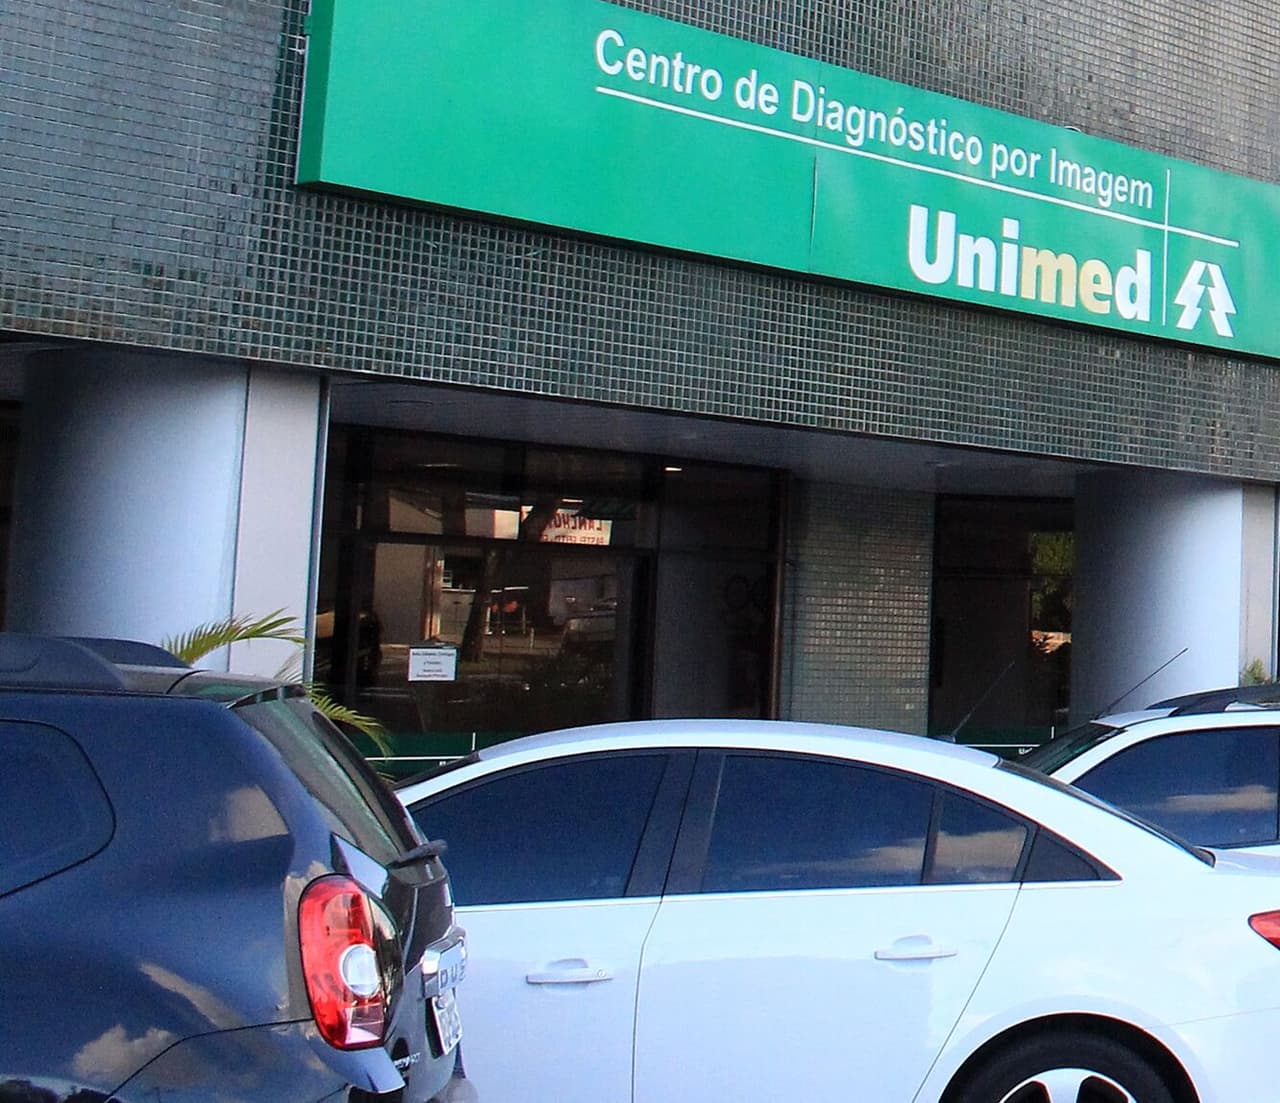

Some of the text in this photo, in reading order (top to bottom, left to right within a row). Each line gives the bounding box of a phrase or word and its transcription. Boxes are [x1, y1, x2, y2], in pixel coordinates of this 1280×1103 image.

[595, 29, 1153, 209] Centro de Diagnóstico por Imagem
[907, 204, 1152, 322] Unimed
